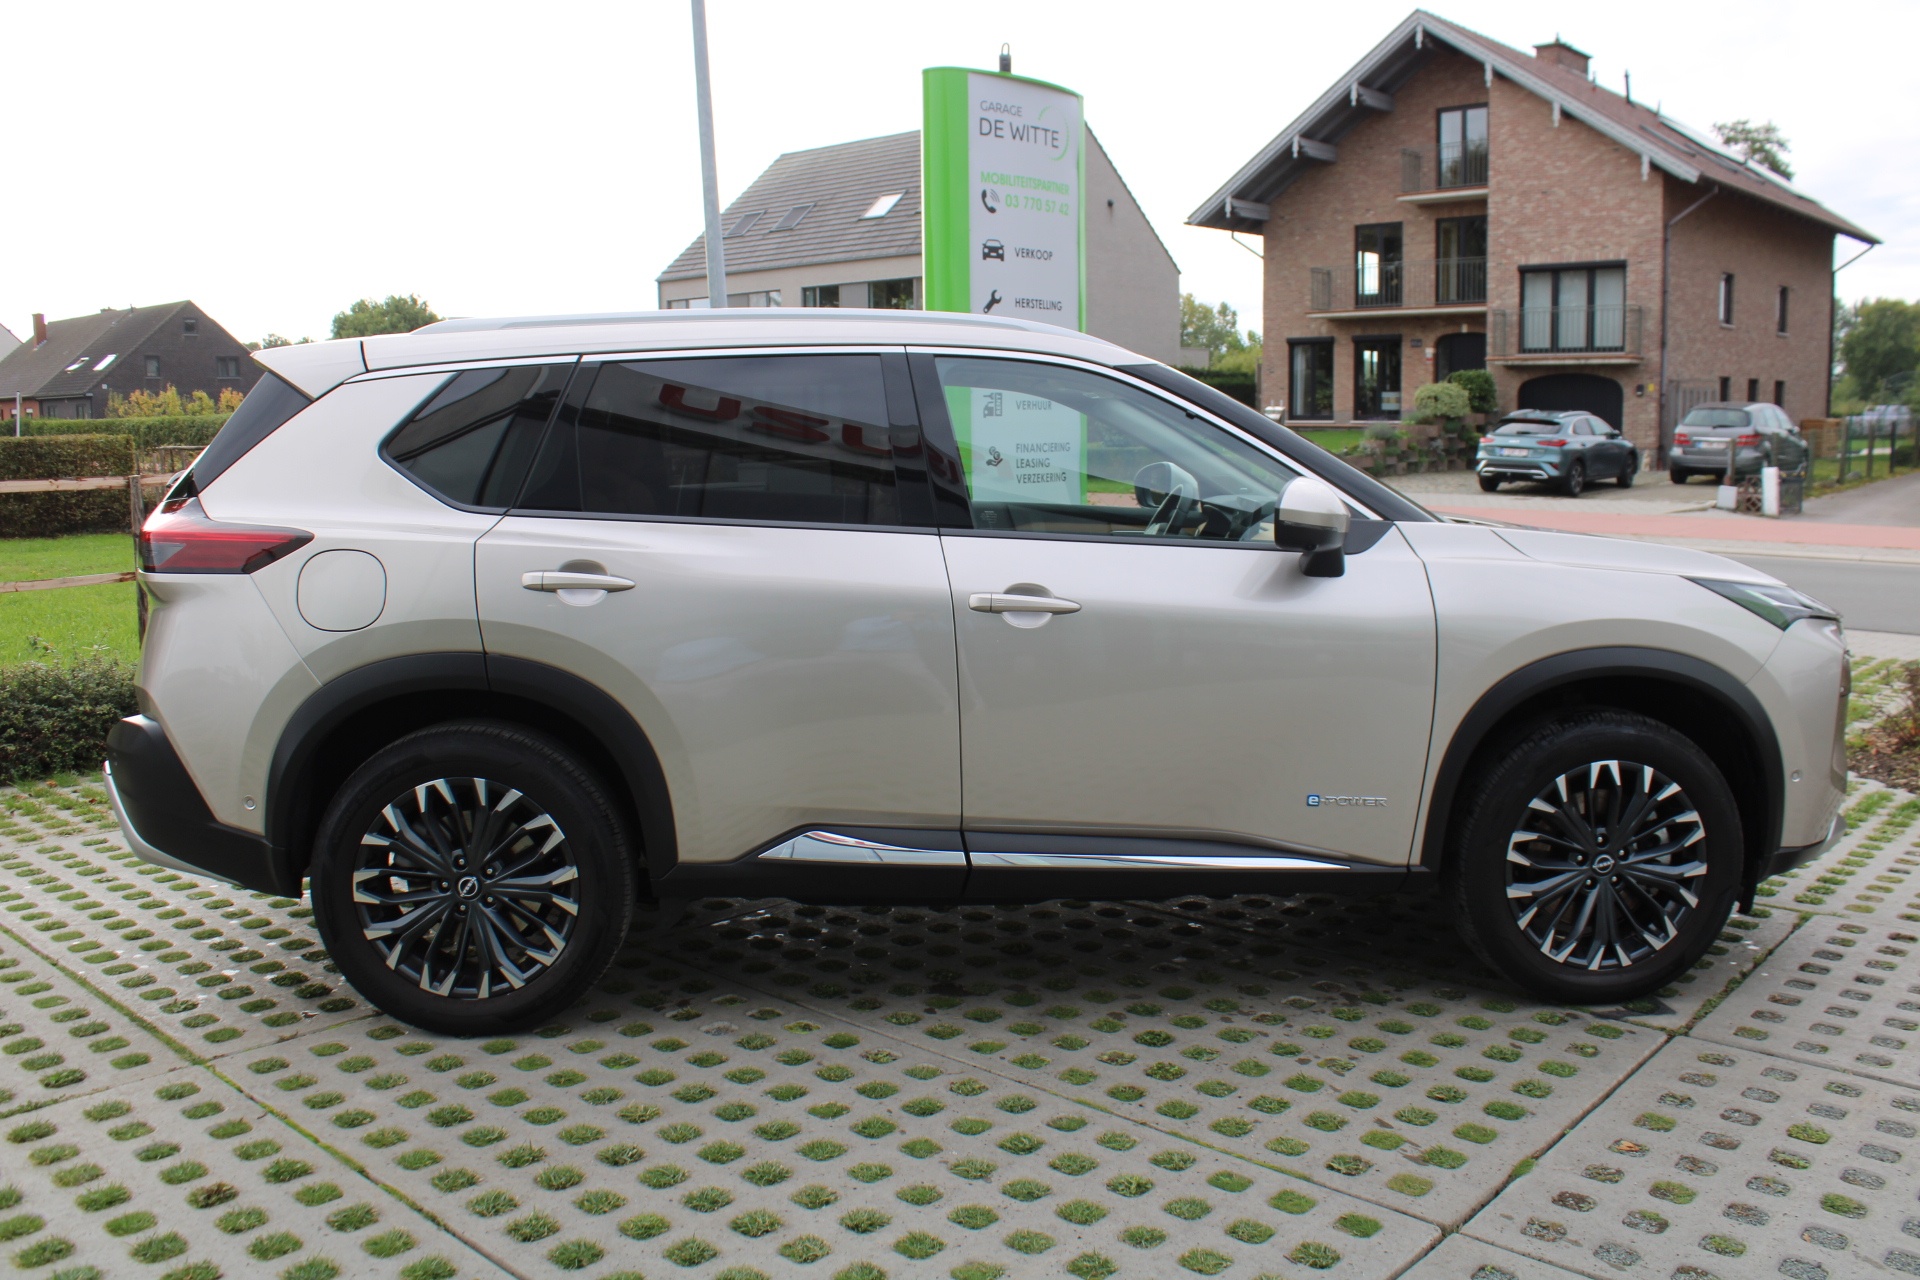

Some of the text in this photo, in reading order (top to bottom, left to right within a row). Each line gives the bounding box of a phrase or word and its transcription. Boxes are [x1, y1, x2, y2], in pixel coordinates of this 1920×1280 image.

[980, 100, 1023, 117] GARAGE
[979, 117, 1060, 148] DE WITTE
[980, 171, 1070, 195] MOBILITEITSPARTNER
[1005, 194, 1069, 215] 03 770 57 42
[1015, 248, 1053, 261] VERKOOP
[1015, 298, 1062, 310] HERSTELLING
[1016, 400, 1052, 411] VERHUUR
[1016, 443, 1071, 453] FINANCIERING
[1016, 458, 1051, 469] LEASING
[1016, 471, 1067, 484] VERZEKERING
